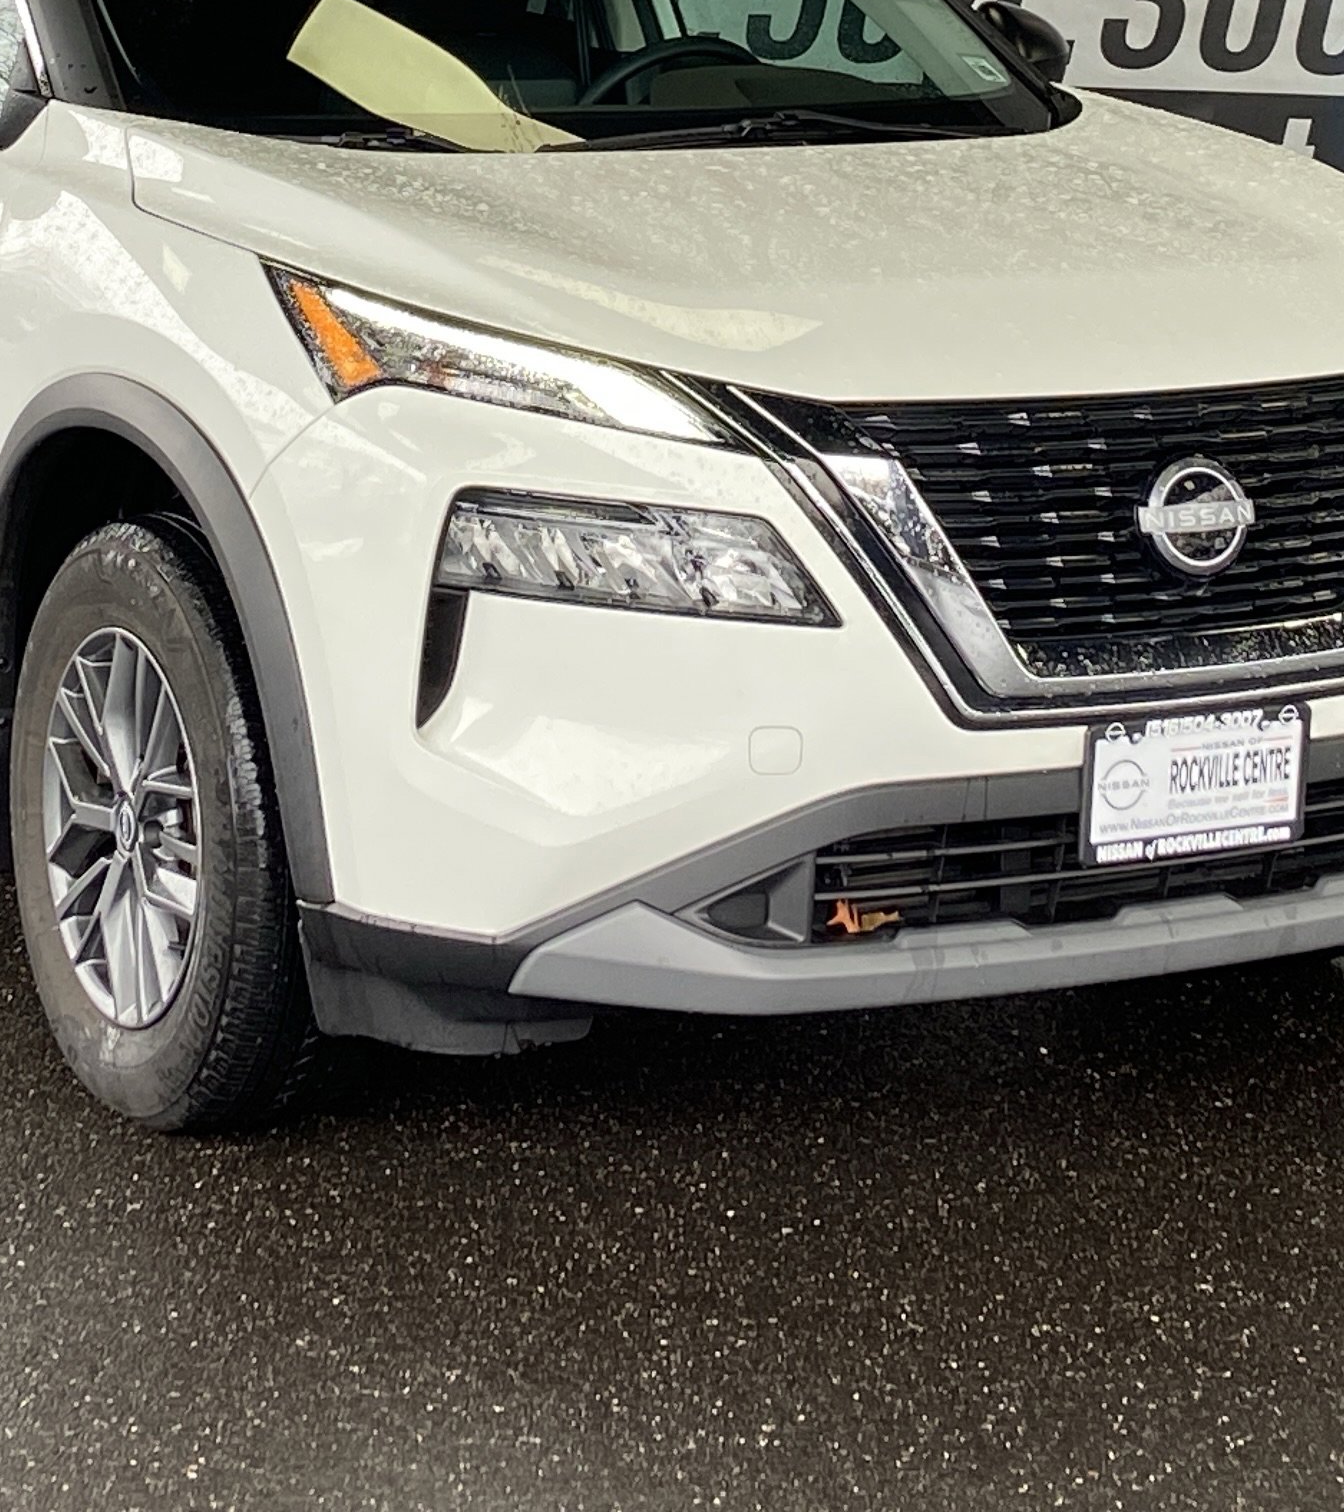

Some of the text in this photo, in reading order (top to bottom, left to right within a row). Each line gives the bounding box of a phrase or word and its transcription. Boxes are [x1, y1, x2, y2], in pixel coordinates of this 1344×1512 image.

[1145, 503, 1253, 529] NISSAN
[1169, 746, 1291, 794] ROCKVILLE CENTRE
[1098, 777, 1150, 791] NISSAN
[1096, 840, 1144, 864] NISSAN
